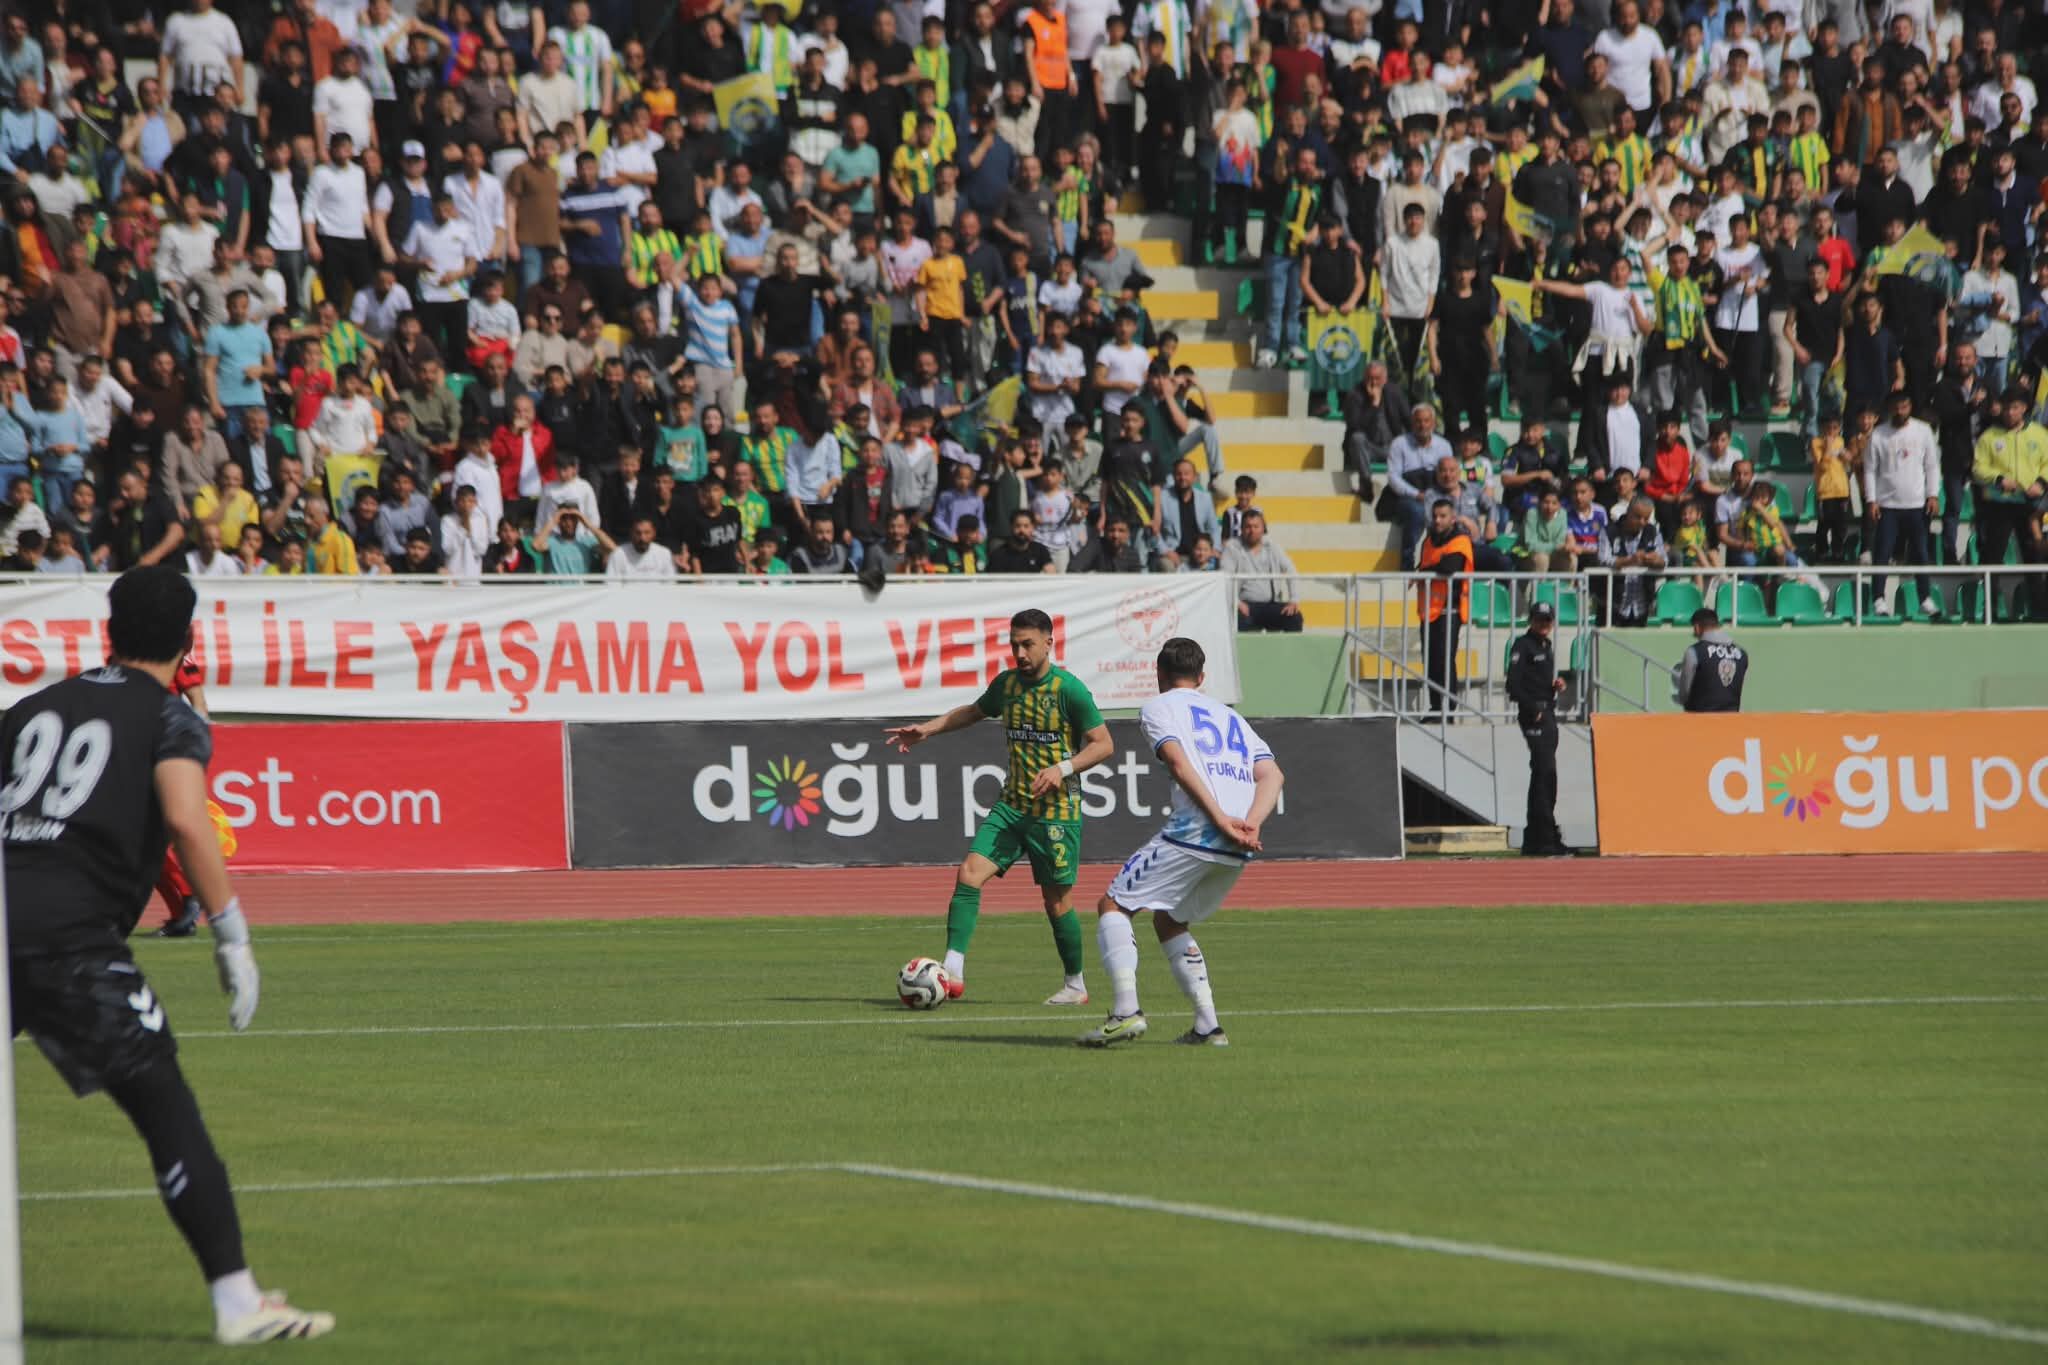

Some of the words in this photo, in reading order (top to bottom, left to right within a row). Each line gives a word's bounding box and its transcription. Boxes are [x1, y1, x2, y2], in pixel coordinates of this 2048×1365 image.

[1, 599, 233, 688] STİ
[263, 600, 375, 690] İLE
[401, 620, 705, 714] YAŞAMA
[724, 620, 864, 694] YOL
[0, 709, 112, 820] 99
[1189, 704, 1249, 766] 54
[1206, 762, 1252, 784] FURKAN
[1052, 842, 1069, 868] 2
